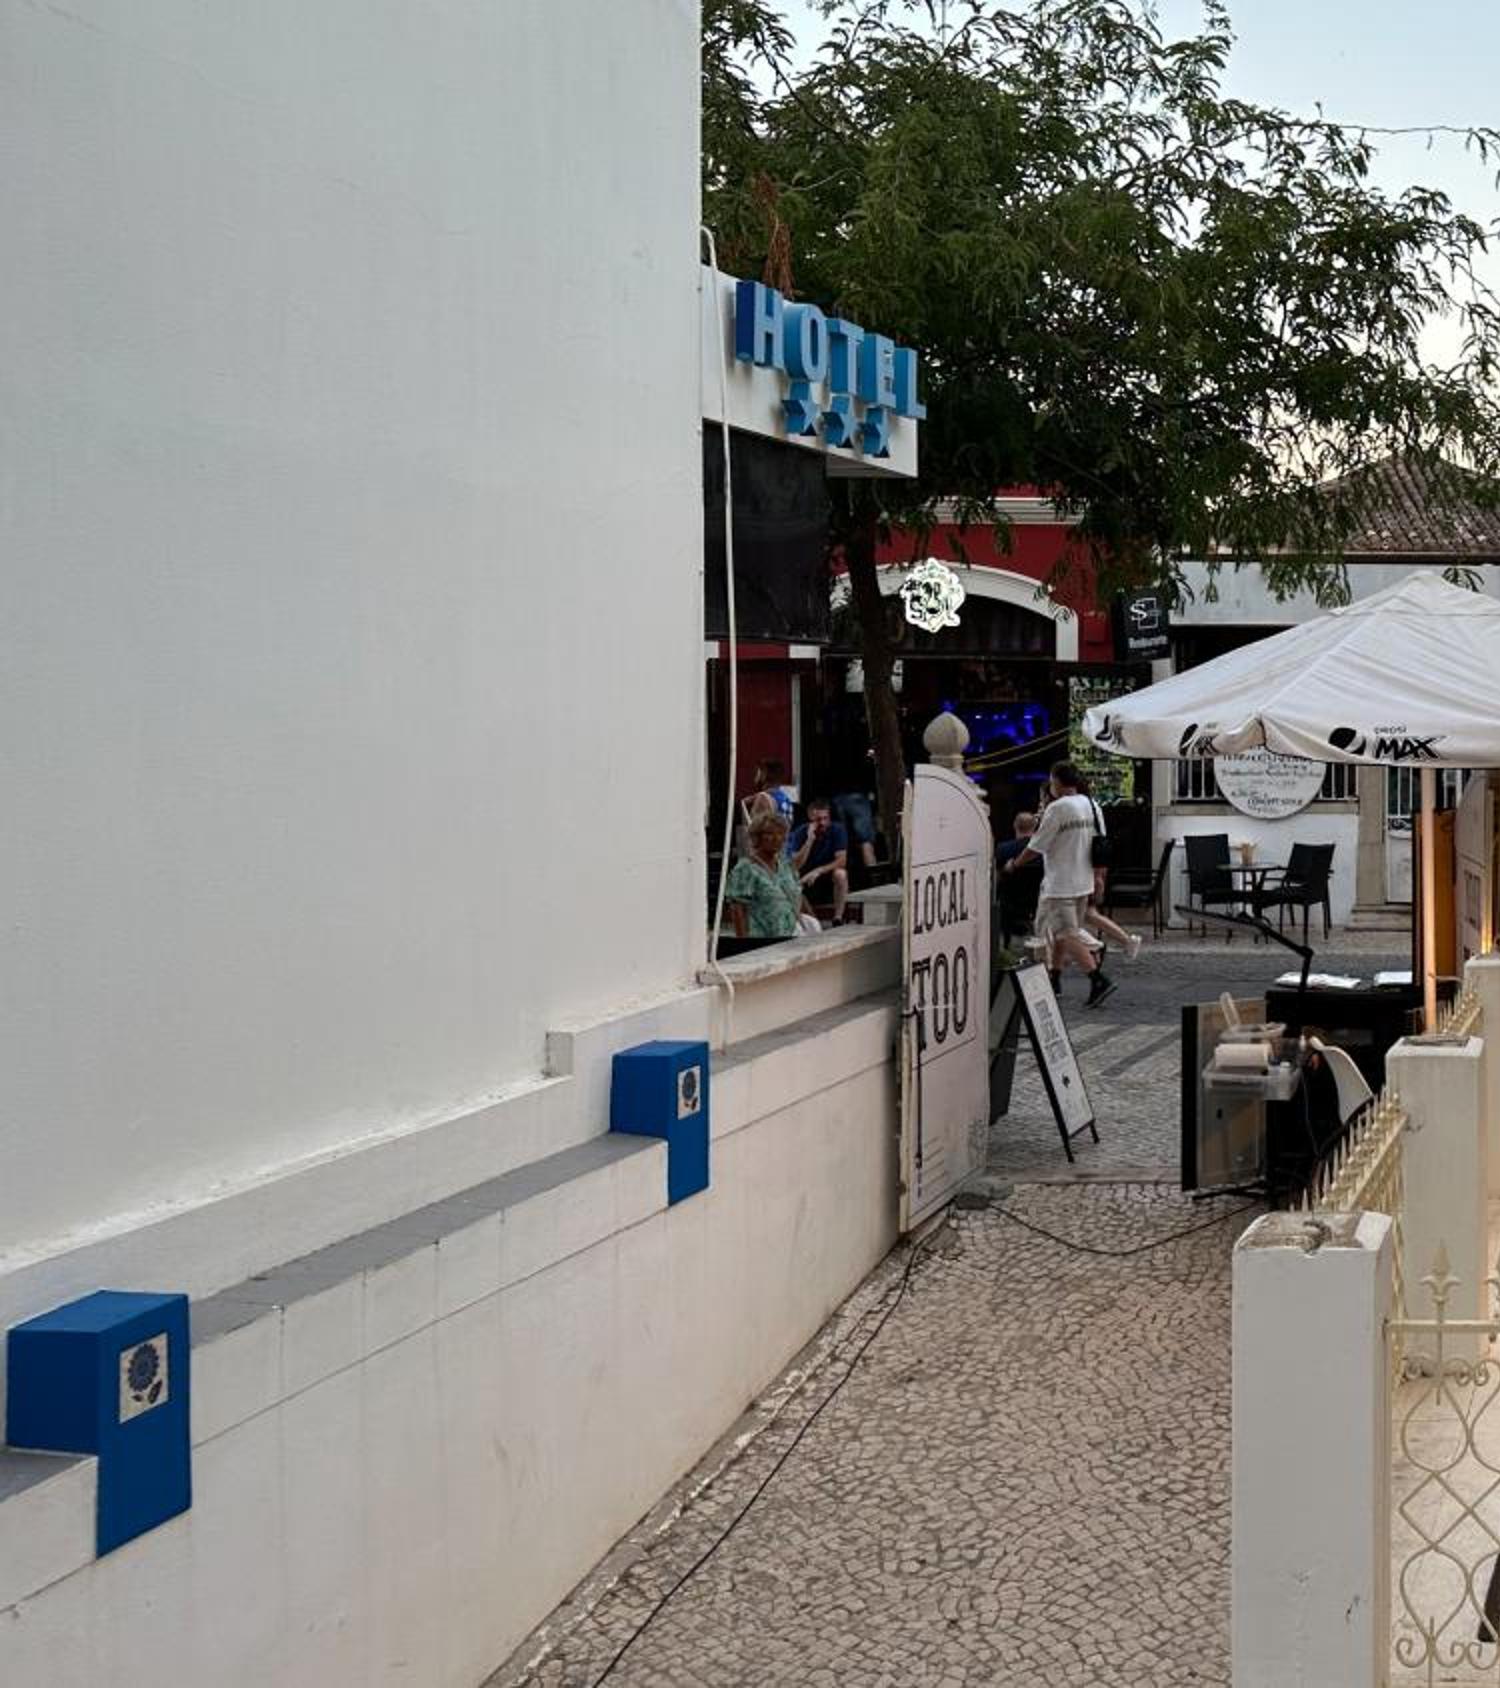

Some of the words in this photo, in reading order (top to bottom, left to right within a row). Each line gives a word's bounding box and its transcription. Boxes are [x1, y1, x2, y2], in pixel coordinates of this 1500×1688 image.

[735, 280, 927, 419] HOTEL
[1374, 735, 1445, 761] MAX
[912, 868, 969, 935] LOCAL
[911, 945, 969, 1051] TOO
